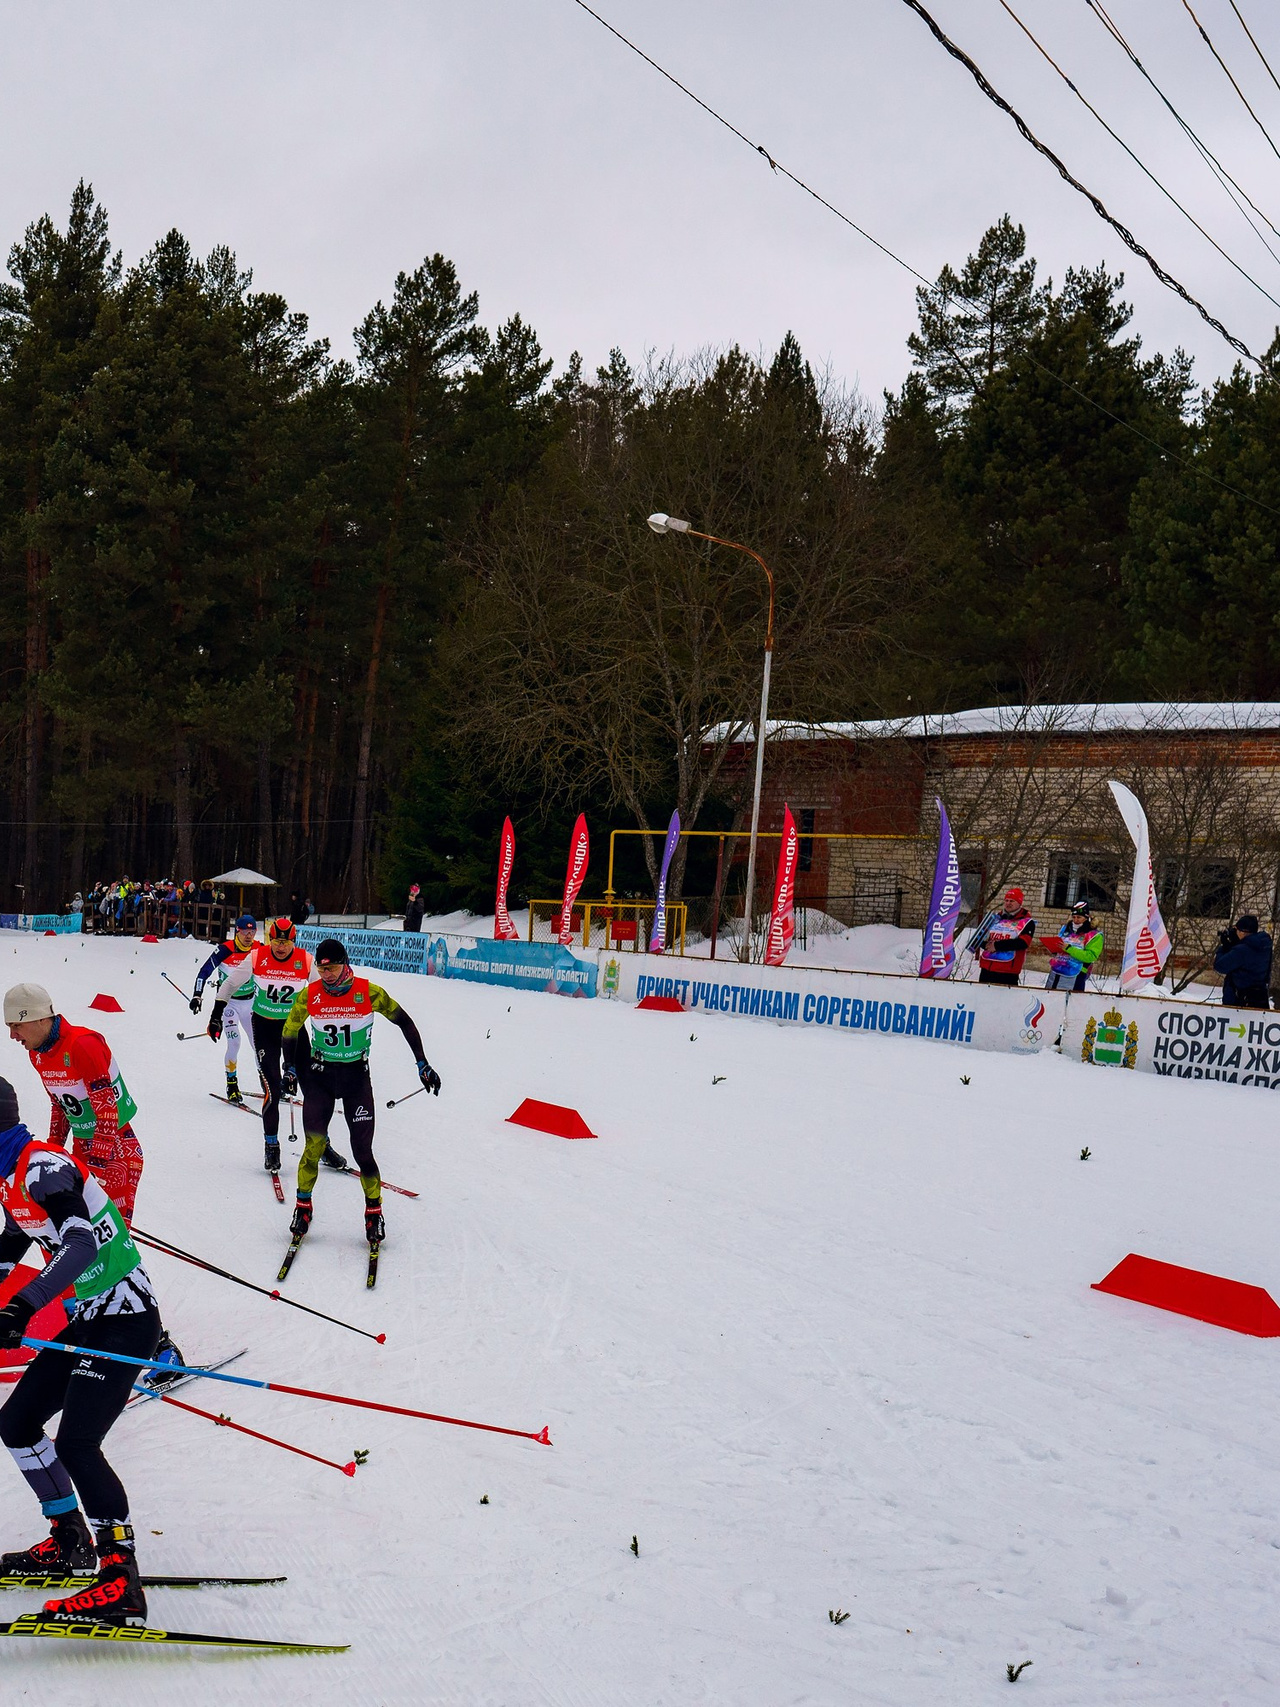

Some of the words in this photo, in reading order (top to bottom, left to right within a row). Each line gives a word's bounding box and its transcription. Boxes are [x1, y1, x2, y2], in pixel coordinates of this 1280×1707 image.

[403, 937, 425, 949] НОРМА
[931, 922, 947, 968] СШОР
[403, 950, 424, 962] ЖИЗНИ
[447, 957, 489, 972] МИНИСТЕРСТВО
[490, 962, 514, 975] СПОРТА
[515, 966, 555, 980] КАЛУЖСКОЙ
[556, 971, 589, 984] ОБЛАСТИ
[267, 984, 295, 1004] 42
[636, 974, 690, 1001] ПРИВЕТ
[690, 980, 799, 1021] УЧАСТНИКАМ
[803, 993, 976, 1043] СОРЕВНОВАНИЙ!
[323, 1024, 352, 1047] 31
[1157, 1011, 1230, 1040] СПОРТ
[1153, 1036, 1242, 1069] НОРМА
[93, 1219, 113, 1245] 25
[71, 1368, 106, 1381] ORDSKI
[7, 1622, 168, 1641] FISCHER
